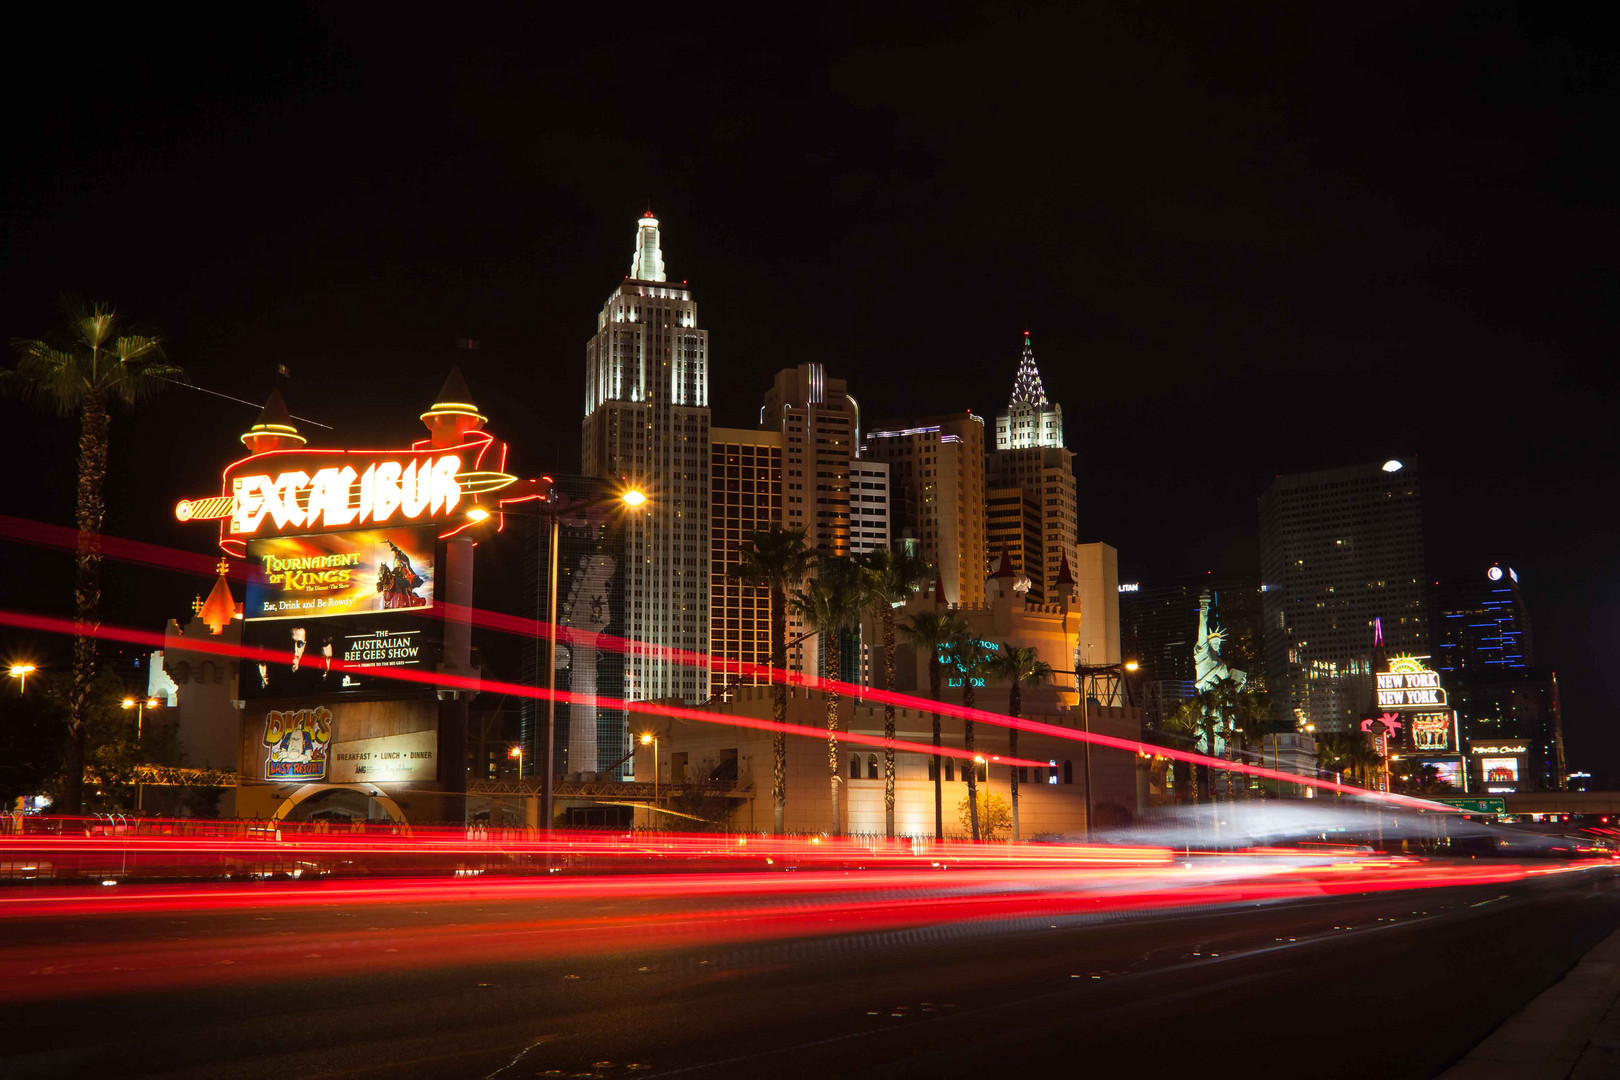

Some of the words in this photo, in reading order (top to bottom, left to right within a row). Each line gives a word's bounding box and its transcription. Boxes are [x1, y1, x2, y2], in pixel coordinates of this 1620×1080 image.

[231, 455, 462, 534] EXCALIBUR
[263, 553, 360, 574] TOURNAMENT
[283, 569, 352, 590] KINGS
[263, 601, 278, 611] Eat,
[279, 600, 301, 610] Drink
[302, 599, 316, 609] and
[317, 598, 327, 608] Be
[328, 596, 356, 607] Rowdy!
[351, 637, 411, 650] AUSTRALIAN
[344, 651, 361, 661] BEE
[362, 649, 386, 660] GEES
[388, 647, 419, 658] SHOW
[948, 678, 985, 687] LUOR
[1376, 674, 1404, 688] NEW
[1404, 673, 1437, 687] YORK
[1377, 691, 1405, 704] NEW
[1405, 690, 1439, 703] YORK
[264, 707, 332, 744] DICK'S
[336, 752, 371, 760] BREAKFAST
[1472, 746, 1499, 754] Monte
[1499, 745, 1526, 753] Carlo
[270, 762, 291, 774] LAST
[293, 762, 322, 774] RESORT
